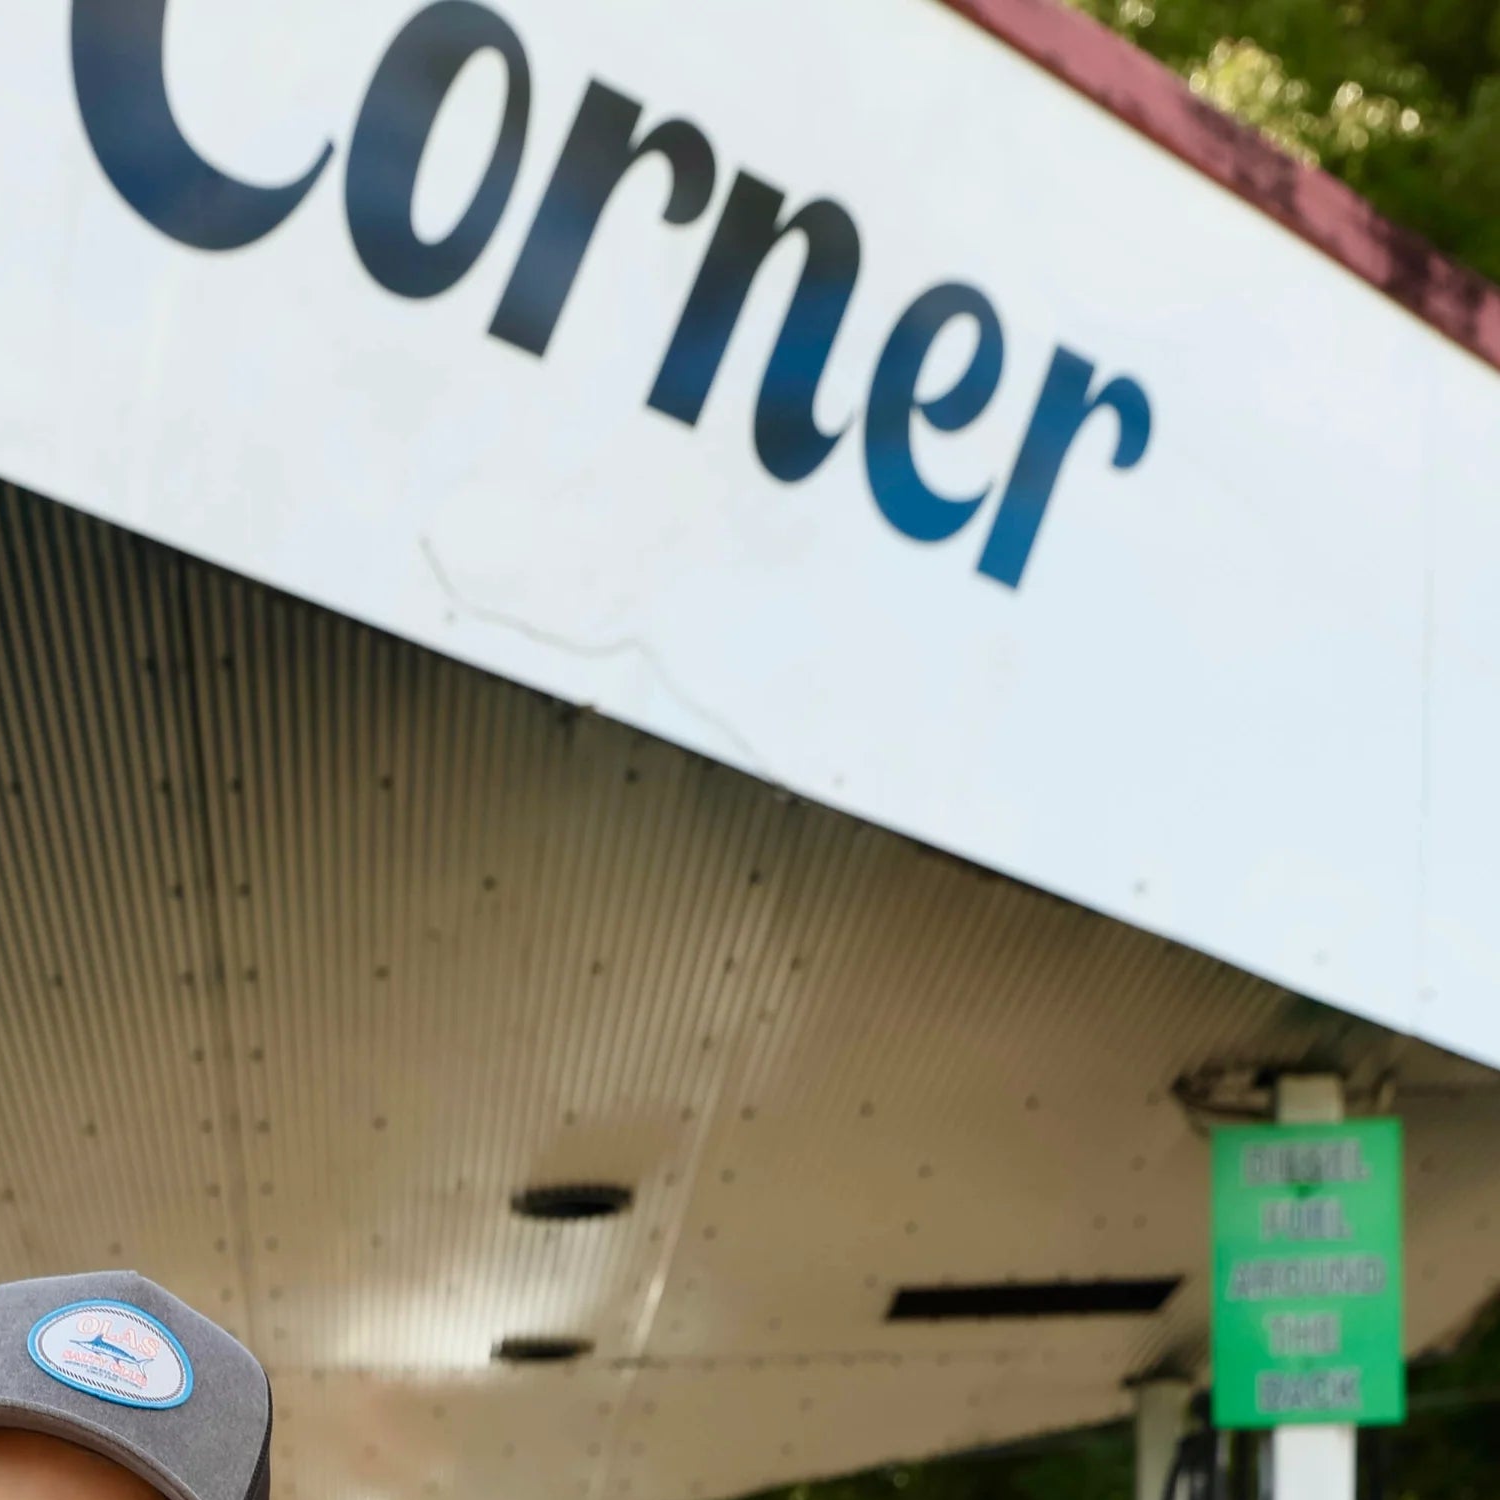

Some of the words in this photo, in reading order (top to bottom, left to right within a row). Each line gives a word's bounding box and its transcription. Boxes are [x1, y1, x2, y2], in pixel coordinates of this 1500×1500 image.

[71, 0, 1151, 590] Corner
[1261, 1197, 1353, 1241] FUEL
[1230, 1254, 1387, 1301] AROUND
[76, 1314, 160, 1358] OLAS
[1265, 1311, 1340, 1355] THE
[1257, 1367, 1361, 1412] BACK
